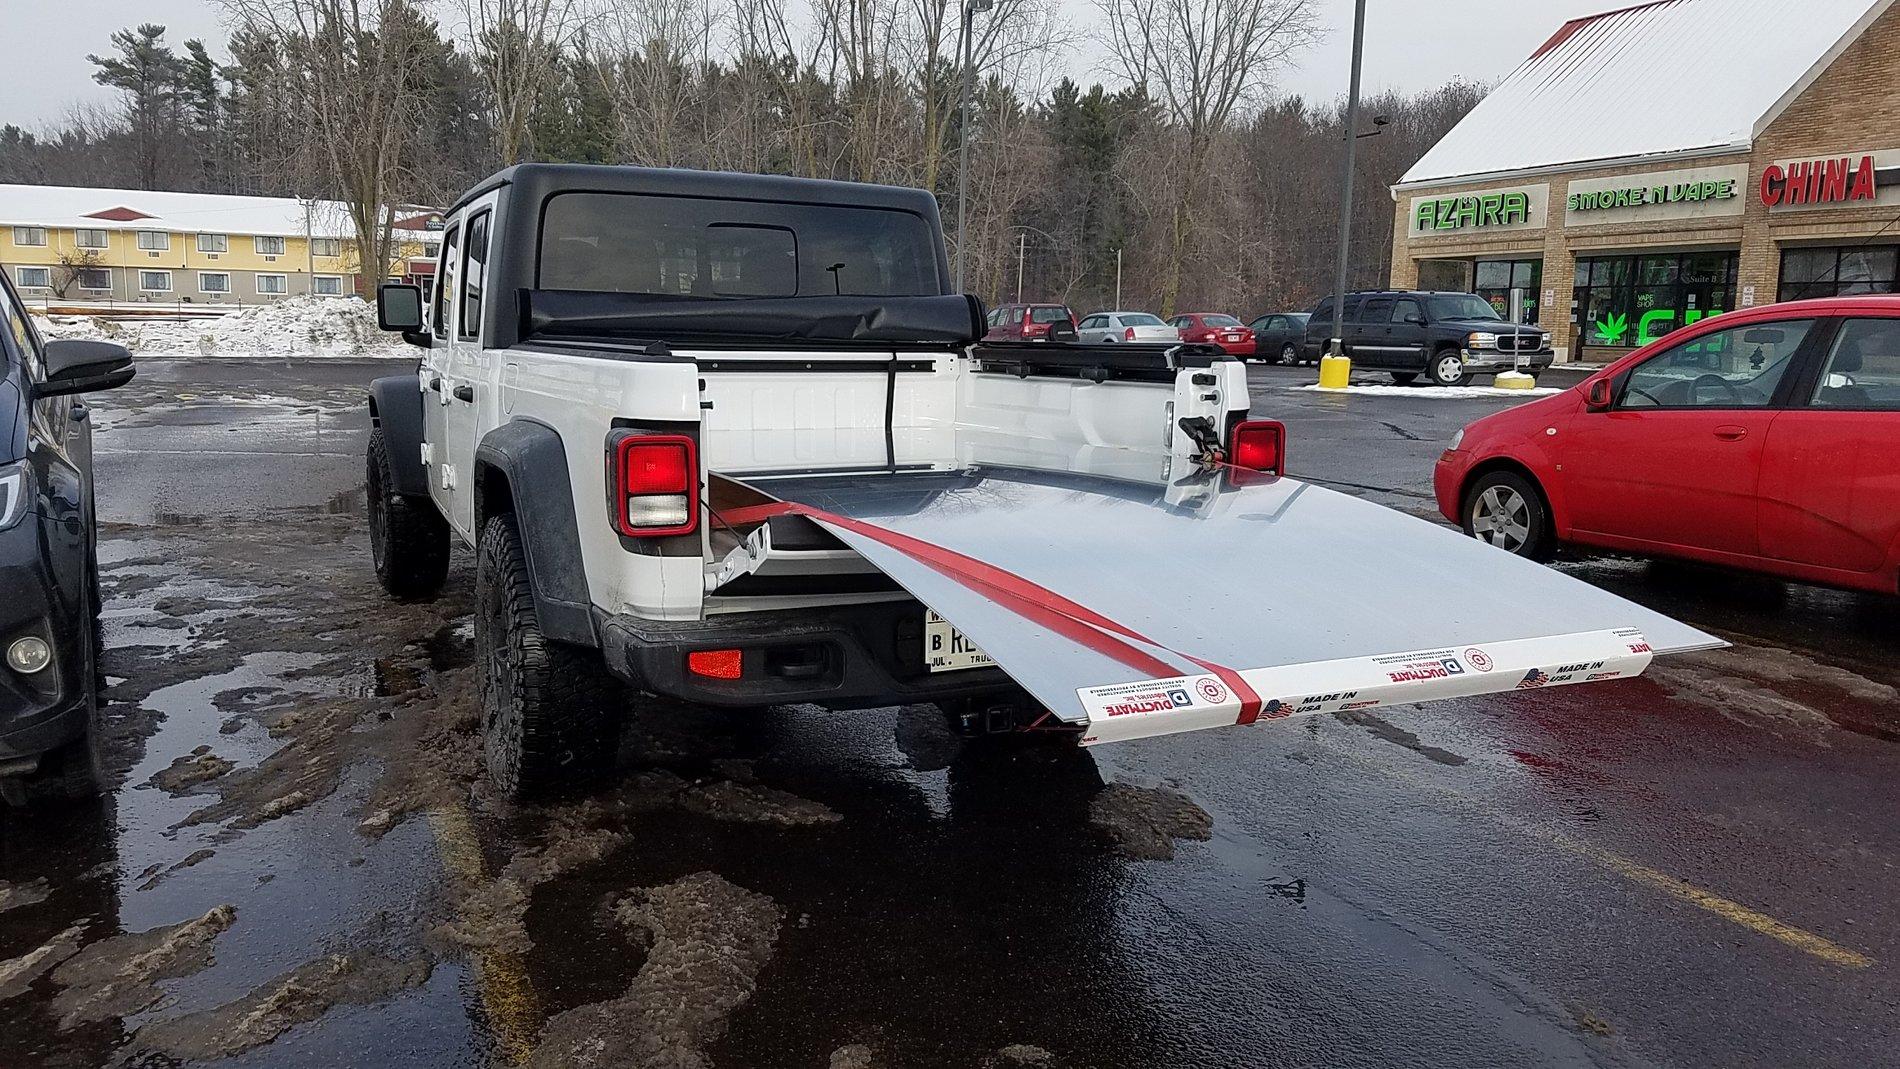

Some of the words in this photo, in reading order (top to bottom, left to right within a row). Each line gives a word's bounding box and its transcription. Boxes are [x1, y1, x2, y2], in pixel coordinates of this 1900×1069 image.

[1760, 156, 1876, 206] CHINA
[1568, 187, 1643, 211] SMOKE
[1672, 180, 1735, 201] VAPE
[1416, 192, 1528, 230] AZARA
[932, 634, 942, 651] B
[932, 657, 945, 667] JUL
[1557, 663, 1589, 673] MADE
[1590, 661, 1604, 670] IN
[1390, 668, 1447, 682] DUCTMATE
[1550, 674, 1572, 682] USA
[1301, 693, 1340, 705] MADE
[1342, 691, 1358, 699] IN
[1105, 699, 1173, 717] DUCTMATE
[1295, 704, 1322, 713] USA
